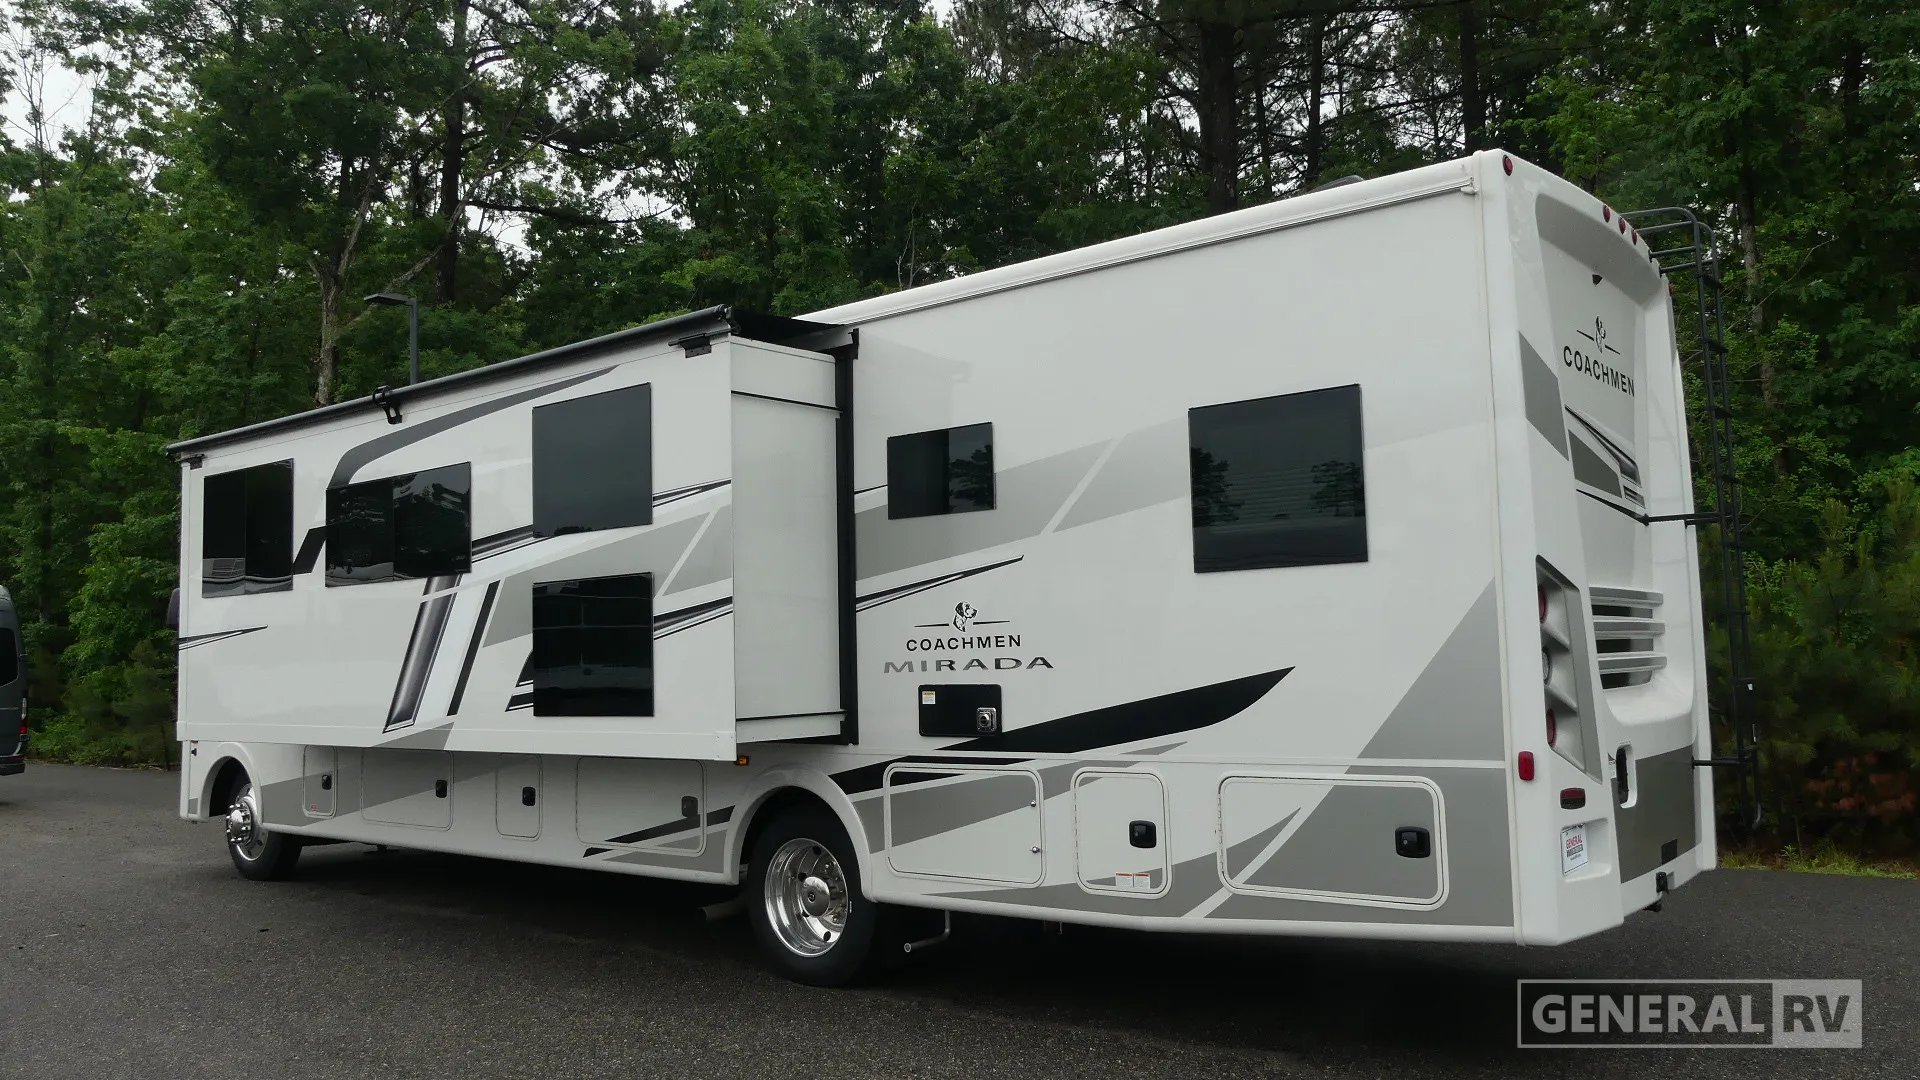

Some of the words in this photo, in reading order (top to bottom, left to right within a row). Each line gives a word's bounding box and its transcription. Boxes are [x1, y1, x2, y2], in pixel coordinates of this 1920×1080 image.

[1563, 345, 1635, 397] COACHMEN
[906, 634, 1021, 651] COACHMEN
[883, 656, 1054, 673] MIRADA
